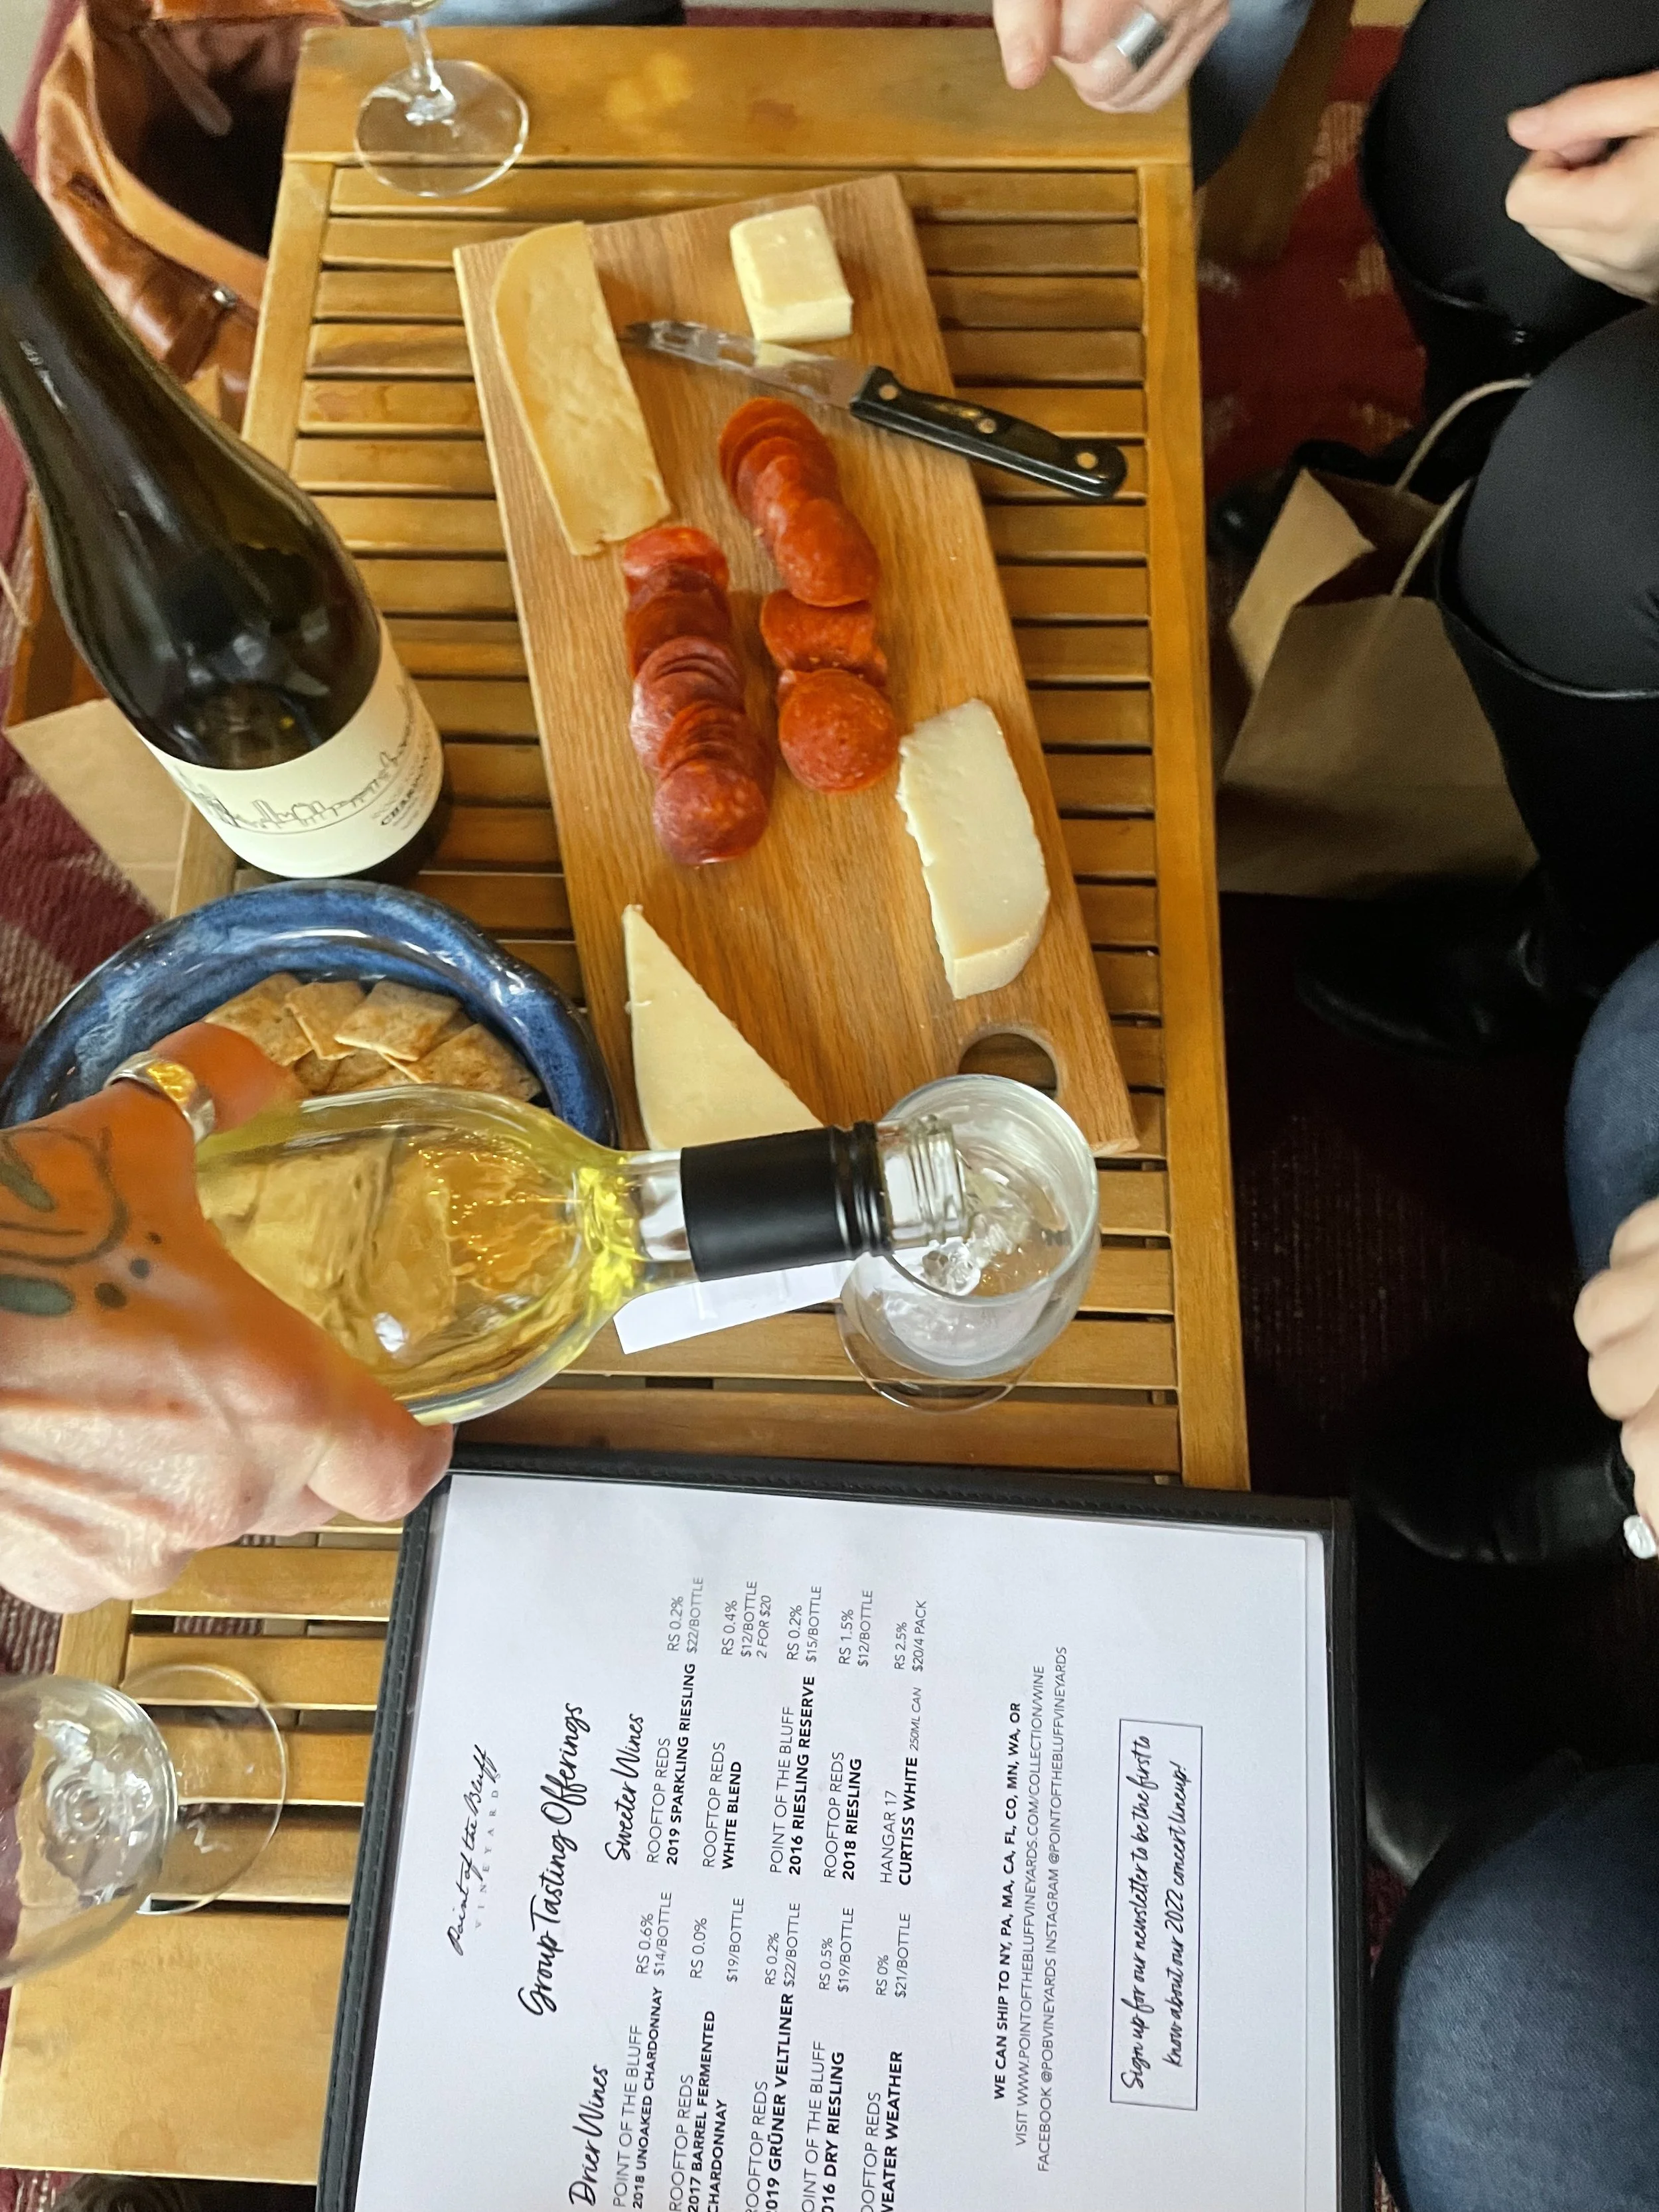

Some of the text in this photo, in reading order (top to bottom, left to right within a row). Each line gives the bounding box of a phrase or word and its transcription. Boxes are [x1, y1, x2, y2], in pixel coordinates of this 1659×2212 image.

[667, 1596, 684, 1651] RS 0.2%
[686, 1578, 703, 1654] $22/BOTTLE
[721, 1600, 738, 1655] RS 0.4%
[741, 1581, 757, 1657] $12/BOTTLE
[757, 1595, 771, 1659] 2 FOR $20
[786, 1605, 802, 1660] RS 0.2%
[806, 1585, 822, 1662] $15/BOTTLE
[839, 1609, 853, 1664] RS 1.5%
[857, 1590, 873, 1667] $12/BOTTLE
[895, 1622, 907, 1670] RS 2.5%
[912, 1600, 926, 1672] $20/4 PACK
[604, 1712, 644, 1862] Sweeter Wines
[646, 1737, 670, 1864] ROOFTOP REDS
[666, 1664, 695, 1866] 2019 SPARKLING RIESLING
[702, 1742, 725, 1868] ROOFTOP REDS
[770, 1706, 794, 1873] POINT OF THE BLUFF
[788, 1676, 815, 1876] 2016 RIESLING RESERVE
[824, 1752, 844, 1878] ROOFTOP REDS
[899, 1687, 921, 1885] CURTISS WHITE 250ML CAN
[1169, 1761, 1190, 1825] lineup!
[447, 1743, 498, 1956] Point of the Bluff
[474, 1771, 501, 1929] VINEYARDS
[518, 1702, 591, 2016] Group Tasting Offerings
[722, 1761, 741, 1870] WHITE BLEND
[842, 1759, 861, 1880] 2018 RIESLING
[880, 1791, 897, 1883] HANGAR 17
[1169, 1825, 1187, 1887] concert
[636, 1913, 653, 1974] RS 0.6%
[653, 1891, 672, 1976] $14/BOTTLE
[690, 1918, 707, 1979] RS 0.0%
[726, 1898, 744, 1982] $19/BOTTLE
[783, 1903, 800, 1988] $22/BOTTLE
[837, 1907, 853, 1992] $19/BOTTLE
[994, 1703, 1021, 2100] WE CAN SHIP TO NY, PA, MA, CA, FL, CO, MN, WA, OR
[1015, 1666, 1045, 2146] VISIT WWW.POINTOFTHEBLUFFVINEYARDS.COM/COLLECTION/WINE
[1038, 1647, 1067, 2172] FACEBOOK @POBVINEYARDS INSTAGRAM @POINTOFTHEBLUFFVINEYARDS
[1121, 1735, 1159, 2090] Sign up for our newsletter to be the first to
[1164, 1889, 1185, 1934] 2022
[1169, 1934, 1185, 1966] our
[764, 1933, 779, 1985] RS 0.2%
[819, 1938, 832, 1990] RS 0.5%
[876, 1955, 889, 1996] RS 0%
[895, 1913, 910, 1998] $21/BOTTLE
[1163, 1968, 1183, 2020] about
[568, 2064, 609, 2206] Drier Wines
[613, 2024, 642, 2207] POINT OF THE BLUFF
[632, 1986, 662, 2209] 2018 UNOAKED CHARDONNAY
[669, 2074, 693, 2212] ROOFTOP REDS
[687, 2011, 715, 2212] 2017 BARREL FERMENTED
[745, 2081, 768, 2212] OOFTOP REDS
[765, 1994, 794, 2212] 019 GRÜNER VELTLINER
[802, 2040, 826, 2212] OINT OF THE BLUFF
[822, 2052, 844, 2212] 016 DRY RIESLING
[865, 2092, 881, 2137] REDS
[881, 2051, 902, 2212] EATER WEATHER
[707, 2097, 727, 2212] CHARDONNAY
